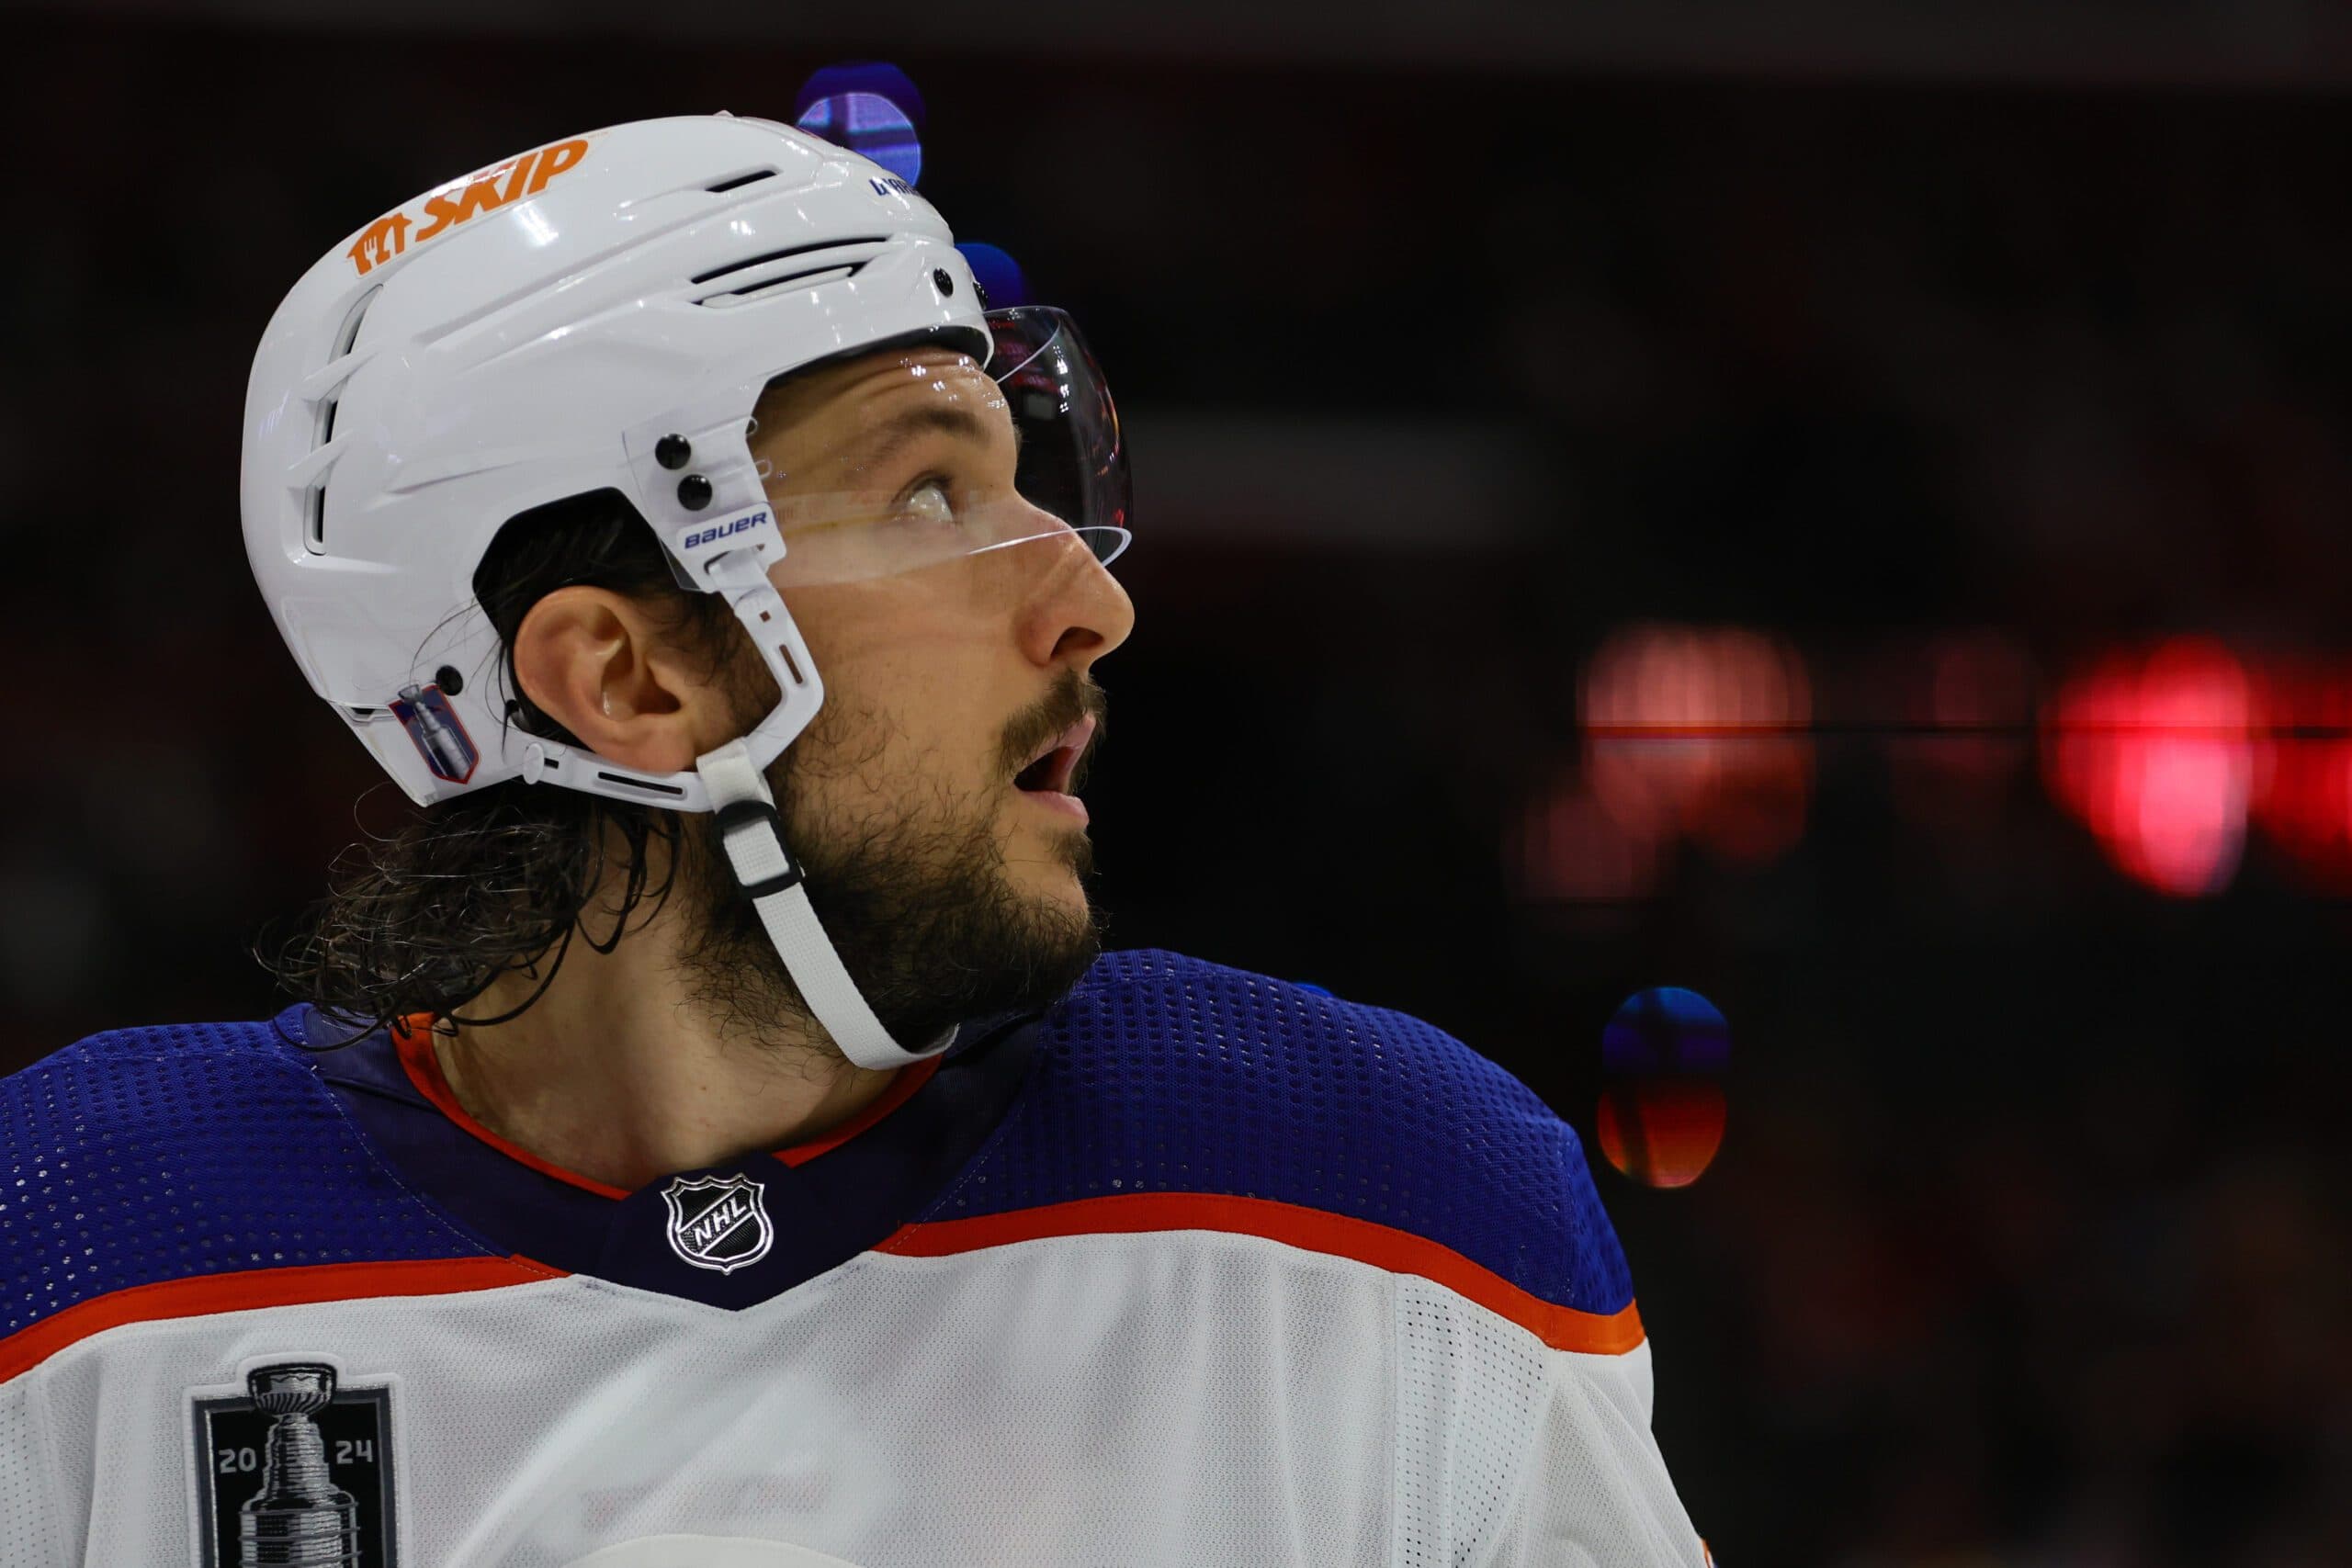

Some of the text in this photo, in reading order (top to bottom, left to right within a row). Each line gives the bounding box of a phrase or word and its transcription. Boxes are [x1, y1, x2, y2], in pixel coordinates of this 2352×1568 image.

[415, 140, 588, 243] SKIP
[684, 512, 767, 549] BAUER
[693, 1196, 748, 1247] NHL
[218, 1439, 373, 1474] 20 24
